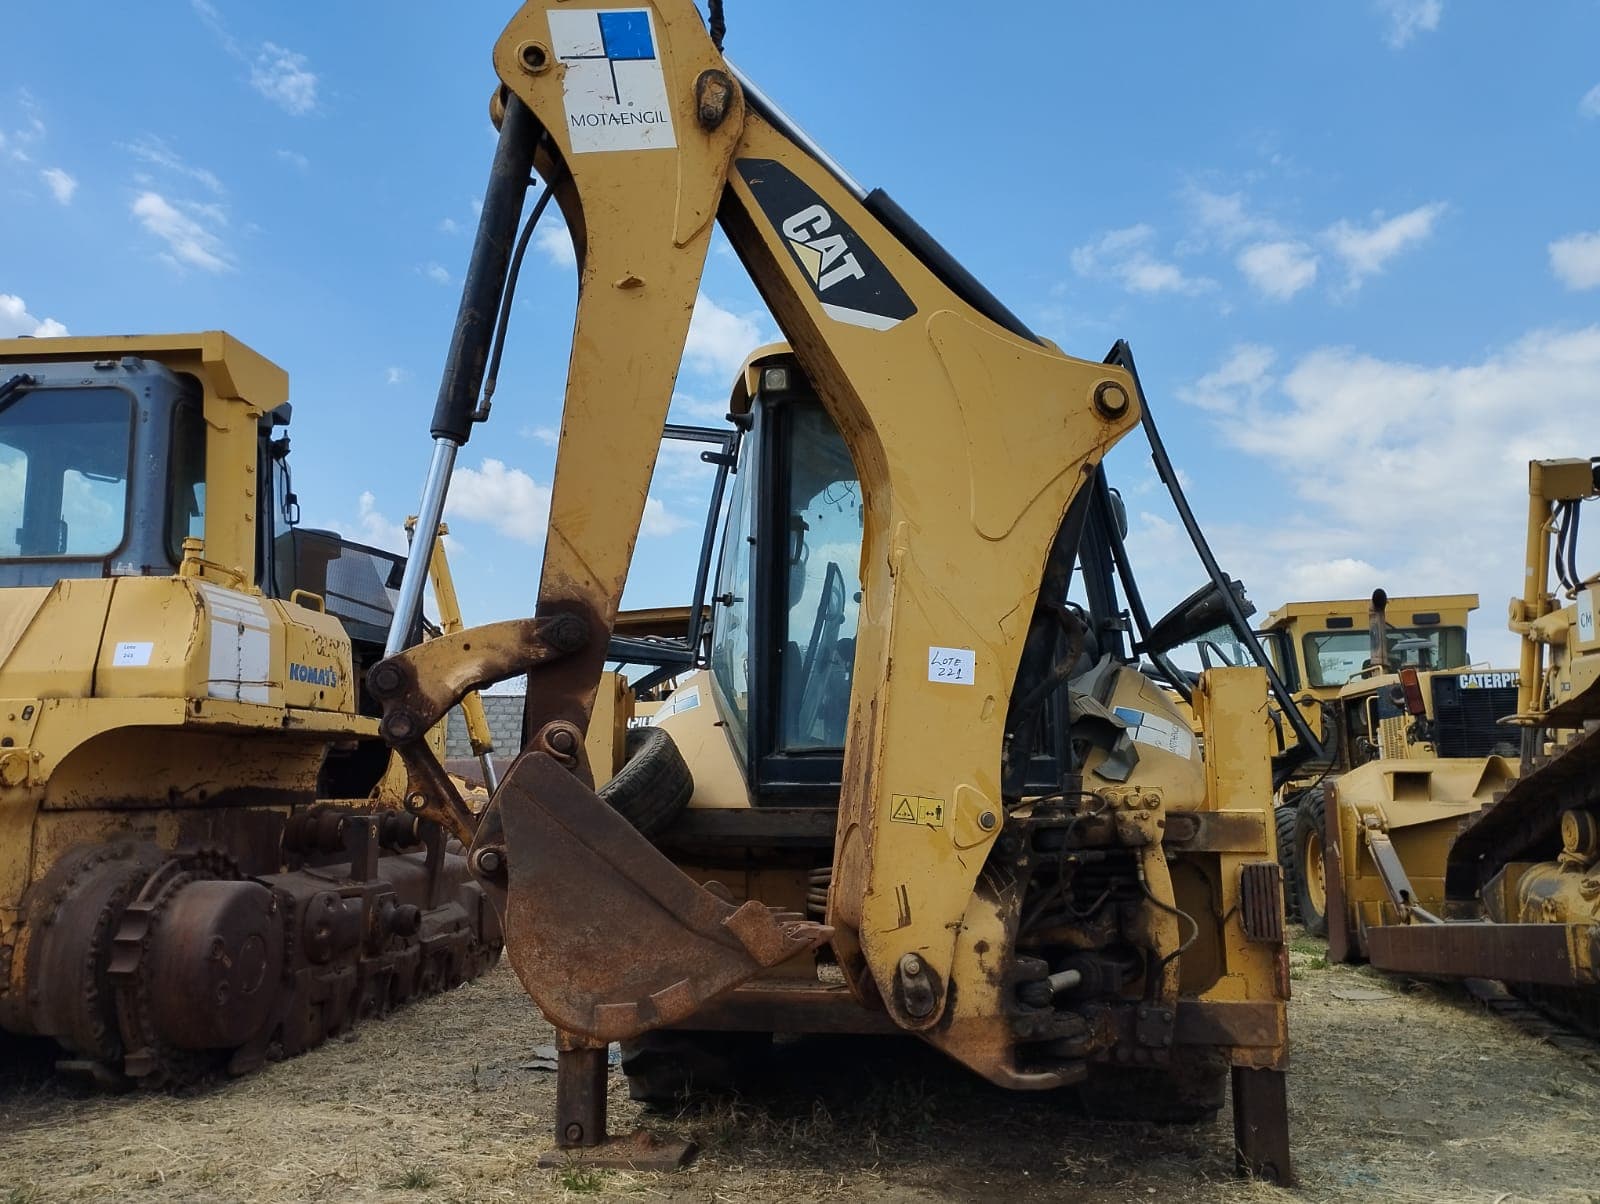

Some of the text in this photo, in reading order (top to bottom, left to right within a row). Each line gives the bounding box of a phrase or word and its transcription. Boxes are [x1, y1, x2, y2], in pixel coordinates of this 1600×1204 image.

[782, 204, 866, 292] CAT
[930, 651, 962, 666] LOTE
[938, 667, 963, 680] 221
